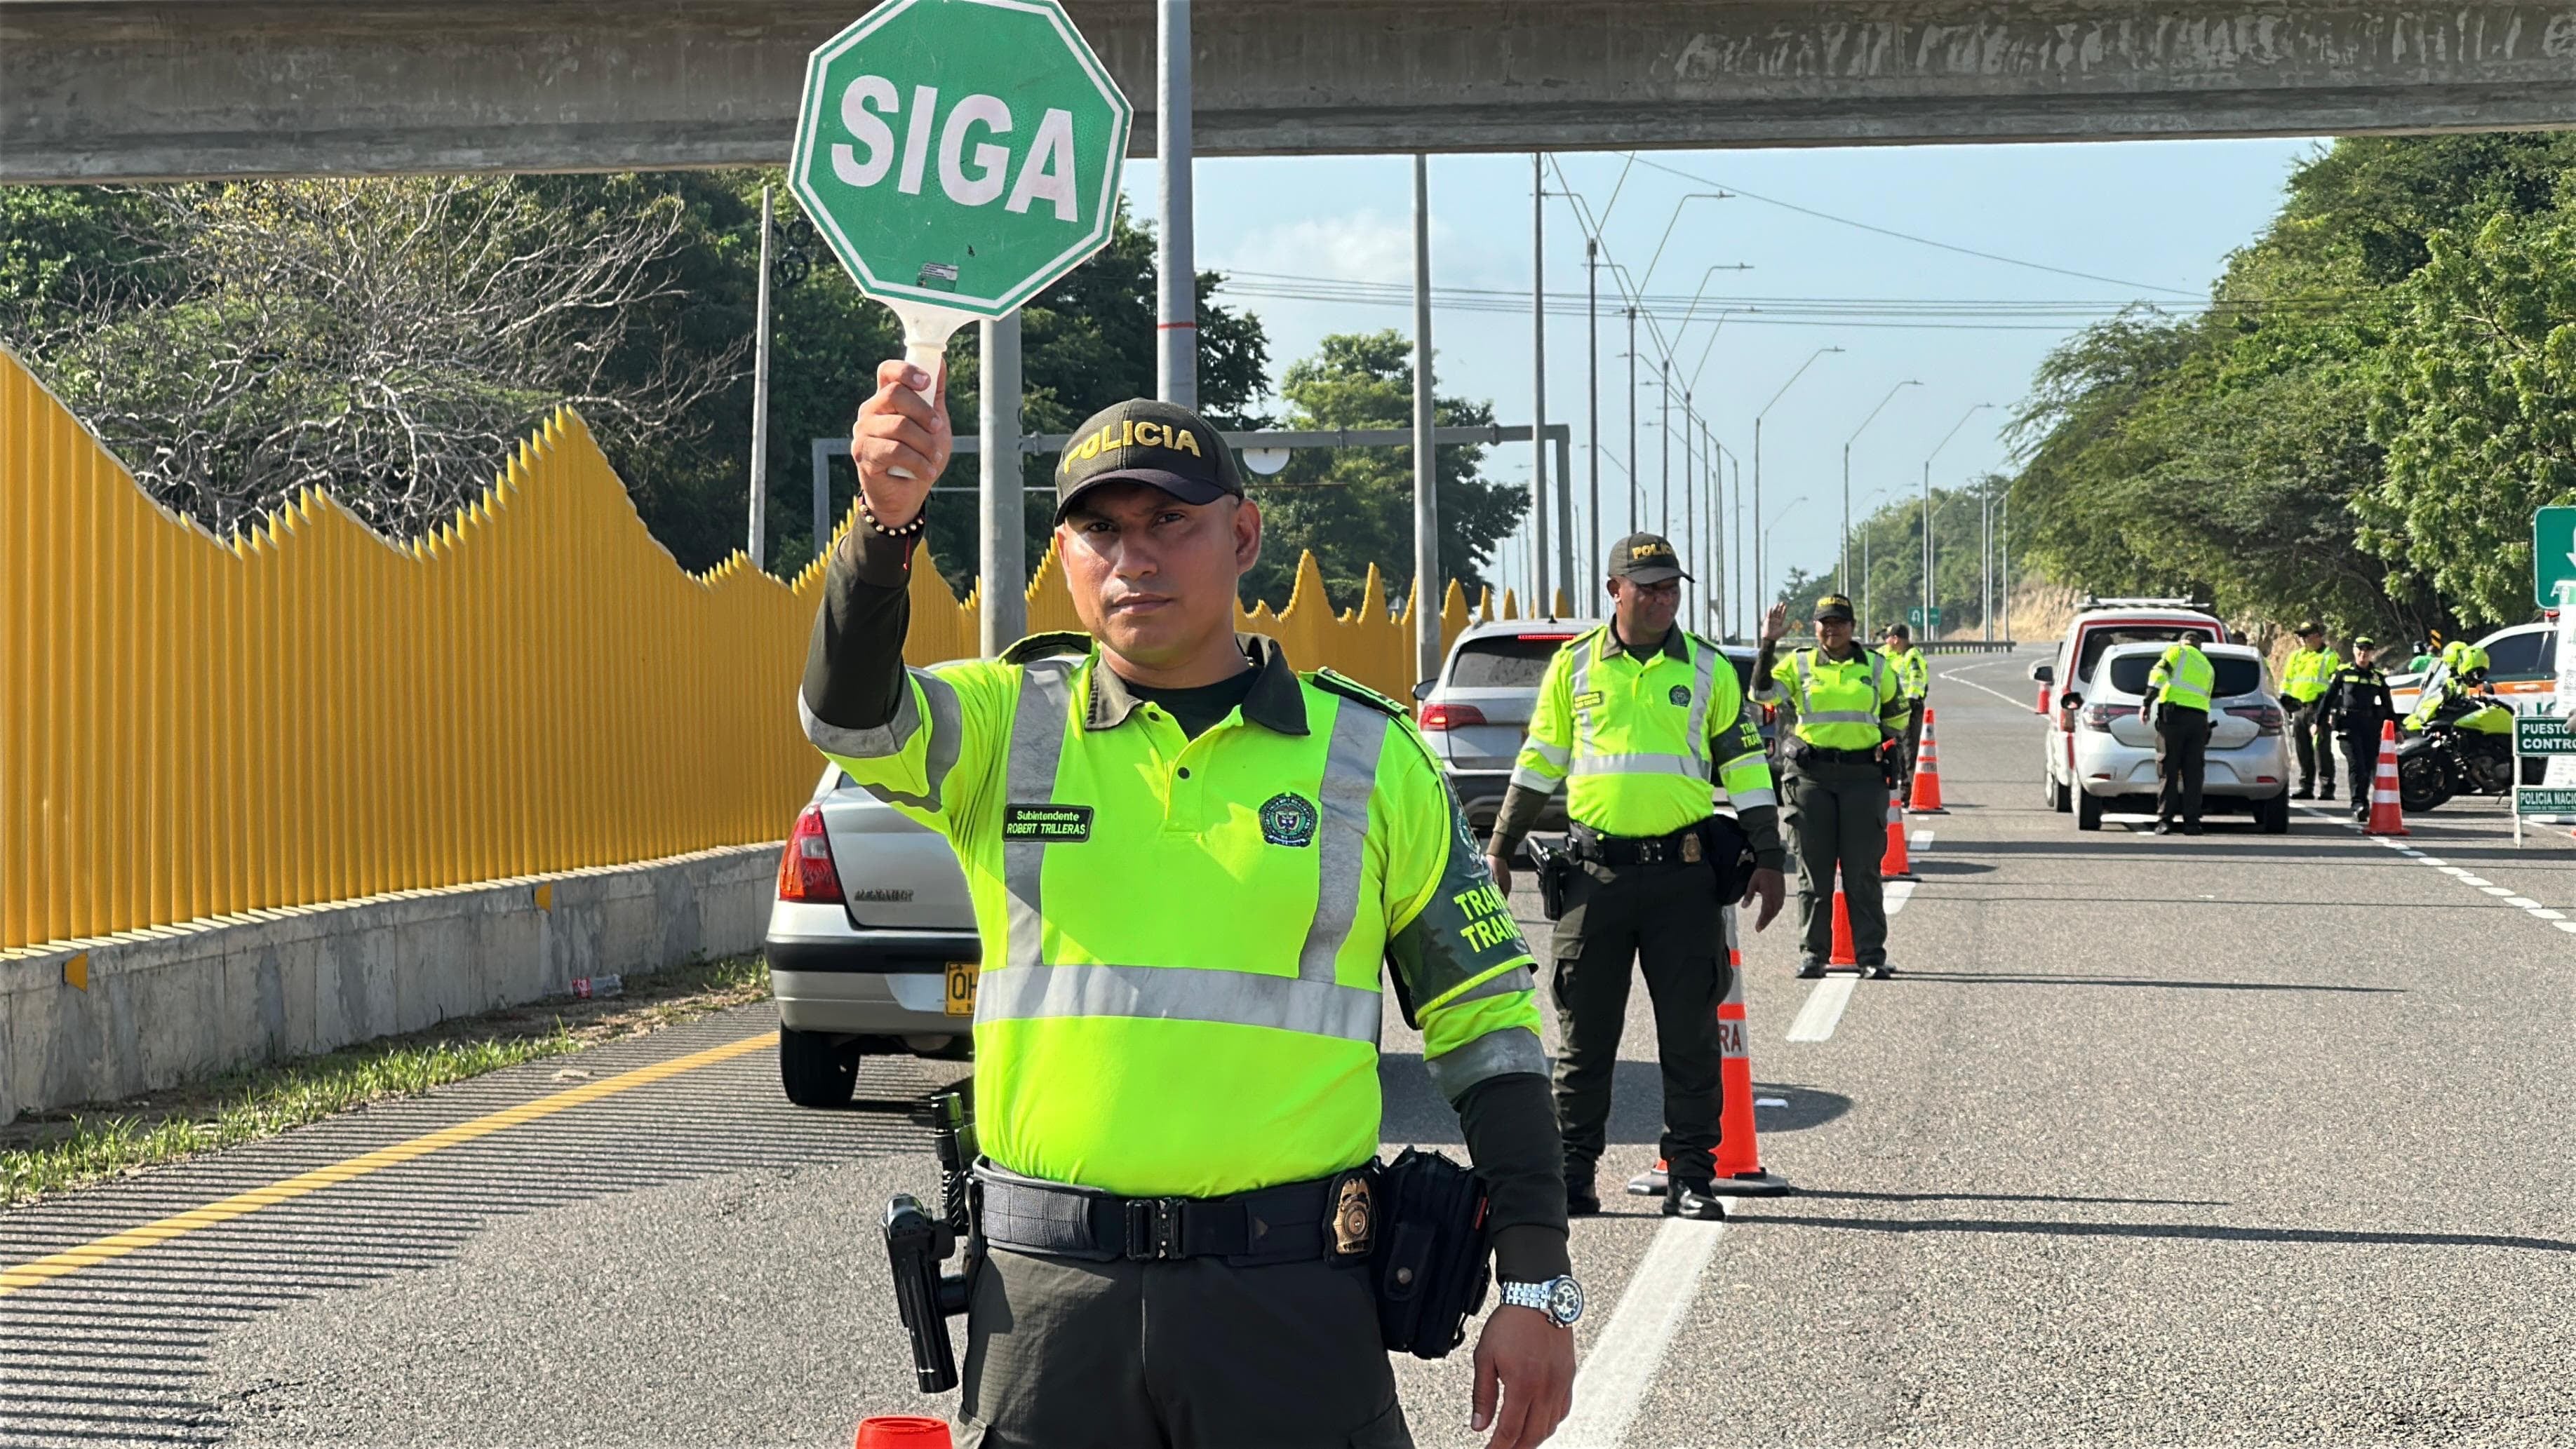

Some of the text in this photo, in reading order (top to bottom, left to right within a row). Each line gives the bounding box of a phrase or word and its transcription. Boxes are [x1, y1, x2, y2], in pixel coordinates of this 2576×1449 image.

[831, 75, 1078, 222] SIGA
[1064, 420, 1201, 474] POLICIA
[1007, 823, 1086, 835] ROBERT TRILLERAS
[1017, 811, 1080, 821] Subintendente
